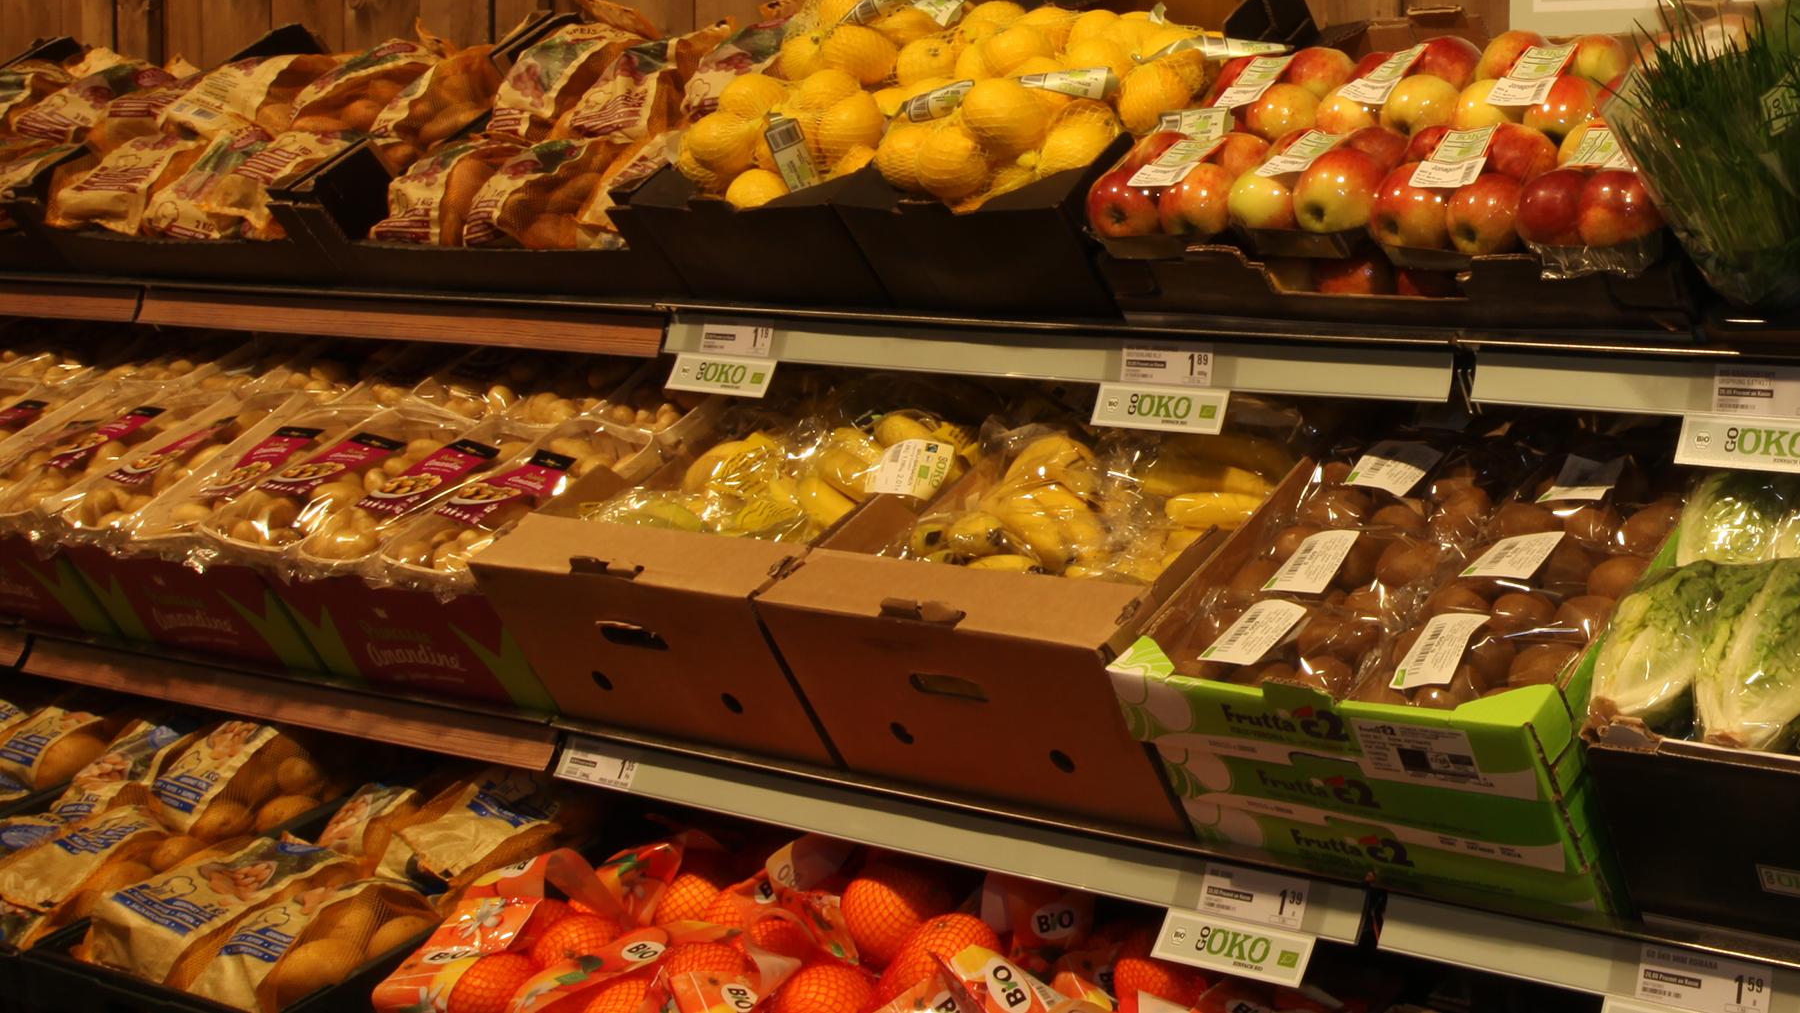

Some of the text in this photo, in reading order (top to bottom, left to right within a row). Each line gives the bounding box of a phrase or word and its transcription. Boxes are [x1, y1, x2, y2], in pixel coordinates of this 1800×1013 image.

[1128, 393, 1139, 415] GO
[1725, 427, 1739, 452] GO
[1221, 702, 1297, 733] Frutta
[1290, 827, 1362, 858] Frutta
[1289, 890, 1304, 906] 39
[1195, 926, 1211, 951] GO
[1688, 957, 1718, 970] ROMANA
[1747, 974, 1764, 994] 59
